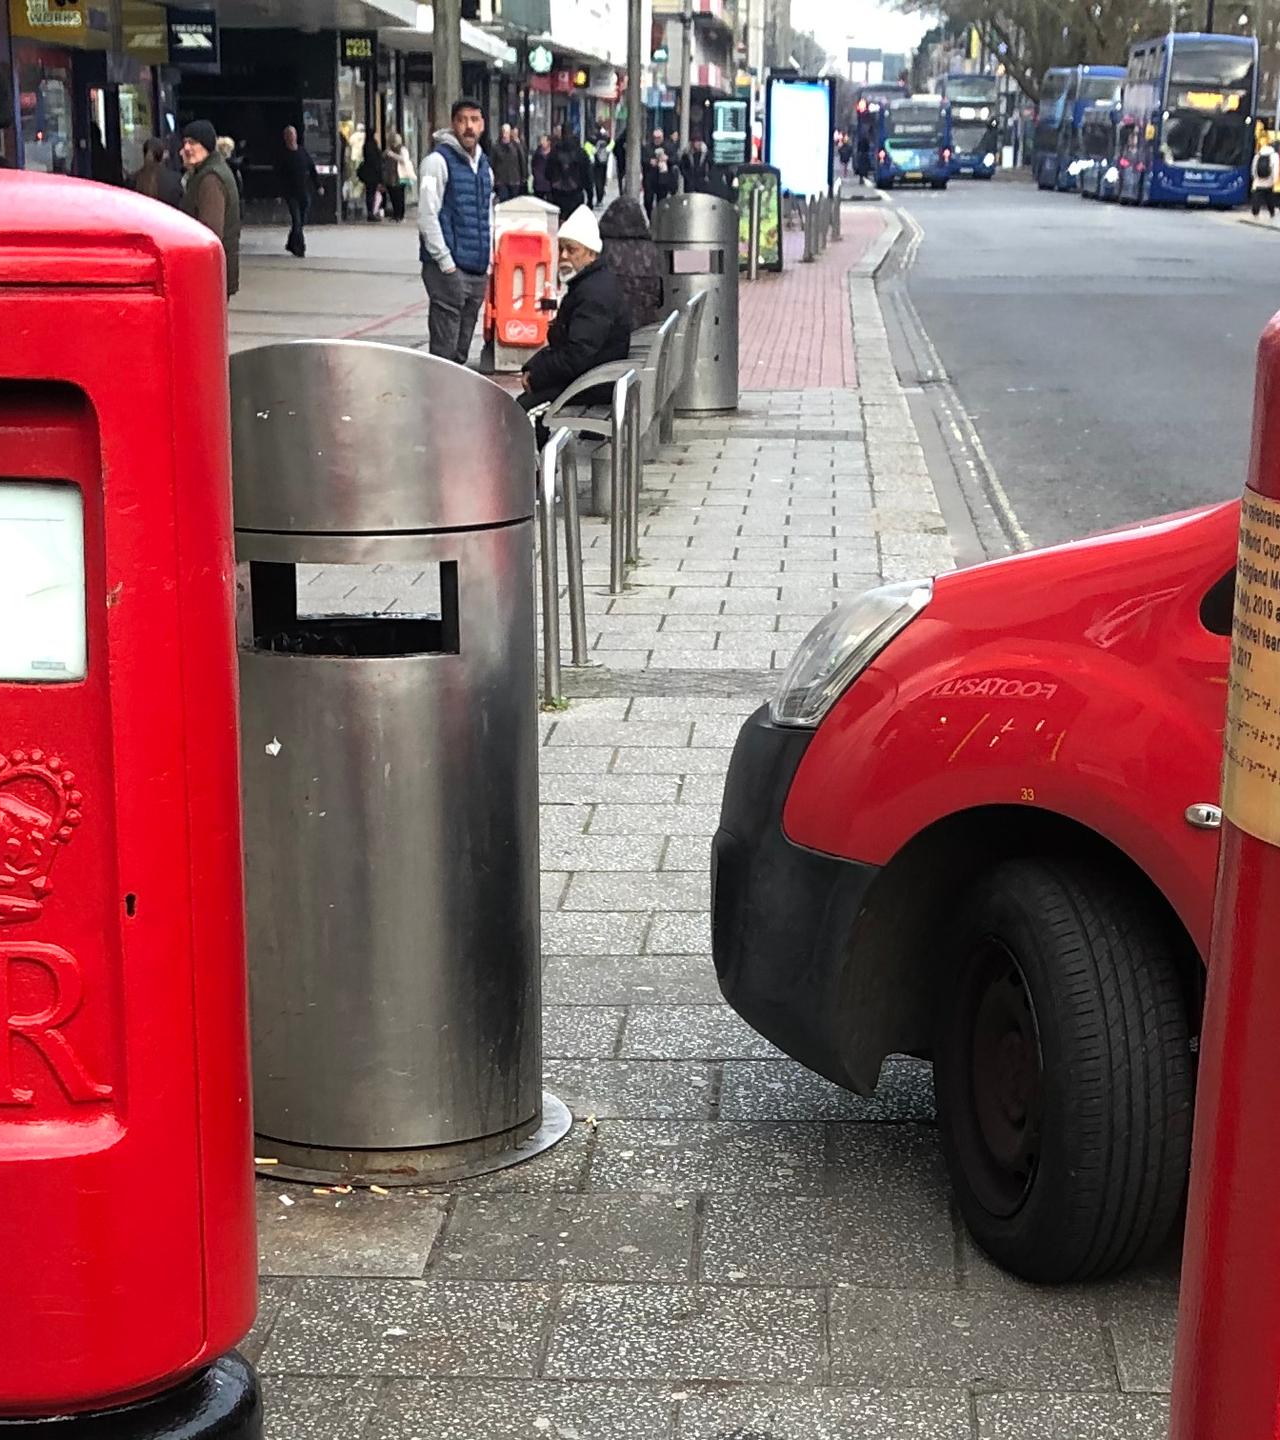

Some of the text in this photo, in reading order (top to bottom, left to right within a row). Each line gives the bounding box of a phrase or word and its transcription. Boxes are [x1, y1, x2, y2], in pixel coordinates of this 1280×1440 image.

[29, 12, 81, 25] WORKS
[346, 38, 371, 48] MOSS
[346, 47, 371, 57] BROS
[1263, 536, 1280, 563] Cup
[1243, 558, 1269, 587] England
[1253, 594, 1273, 619] 2019
[1021, 787, 1035, 801] 33
